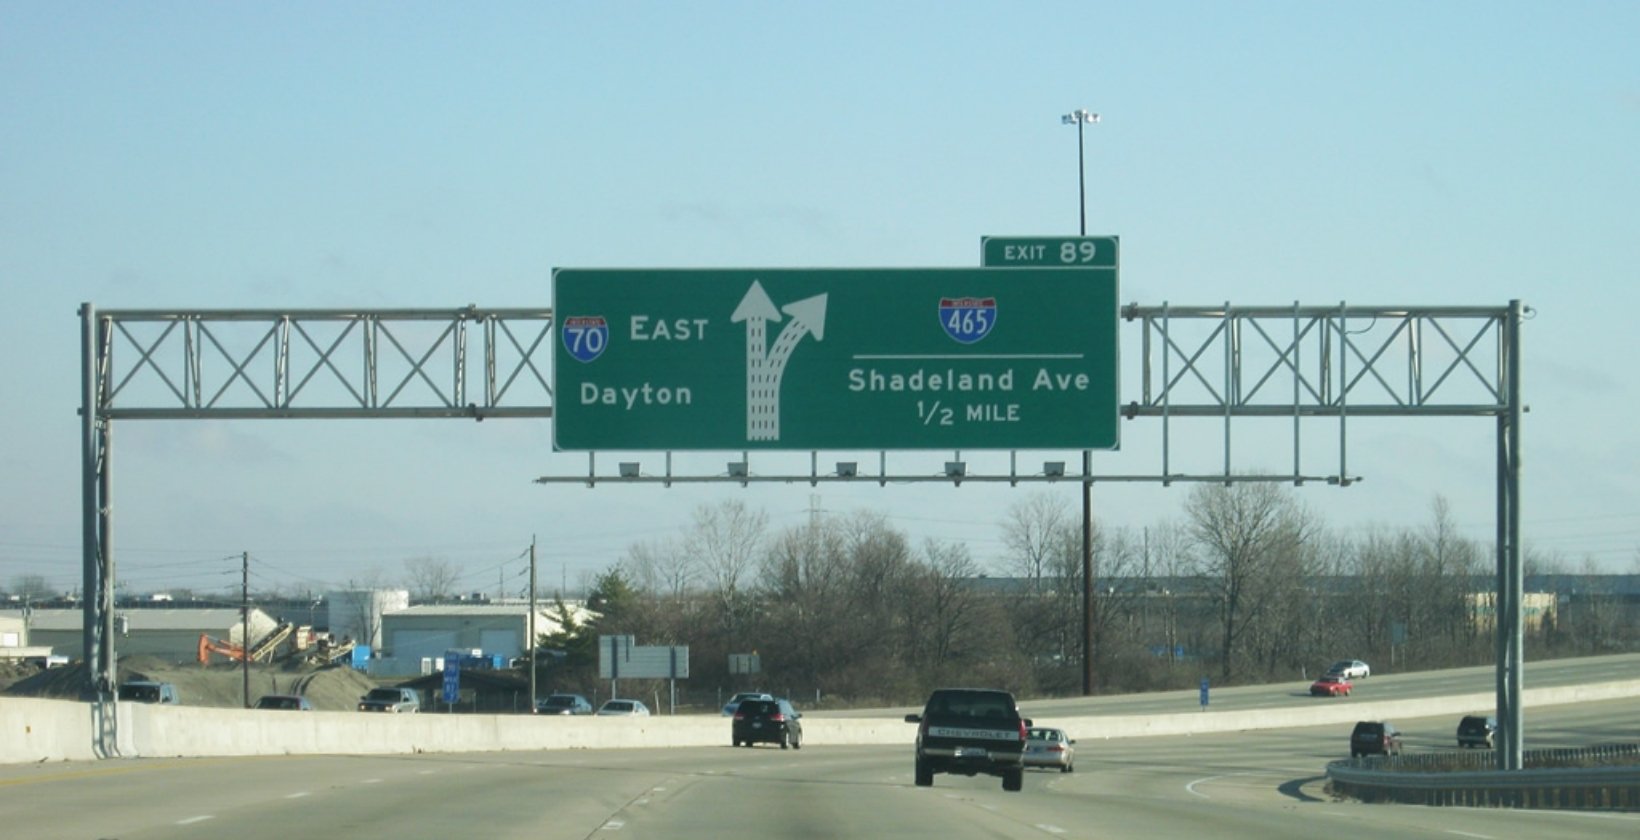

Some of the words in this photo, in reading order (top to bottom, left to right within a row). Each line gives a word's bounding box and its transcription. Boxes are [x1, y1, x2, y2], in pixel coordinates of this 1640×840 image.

[1005, 246, 1045, 259] EXIT
[1060, 242, 1096, 263] 89
[630, 315, 709, 340] EAST
[948, 309, 988, 335] 465
[568, 328, 603, 353] 70
[848, 369, 1013, 391] Shadeland
[1033, 369, 1090, 390] Ave
[580, 382, 692, 410] Dayton
[917, 401, 954, 425] 1/2
[966, 404, 1020, 421] MILE
